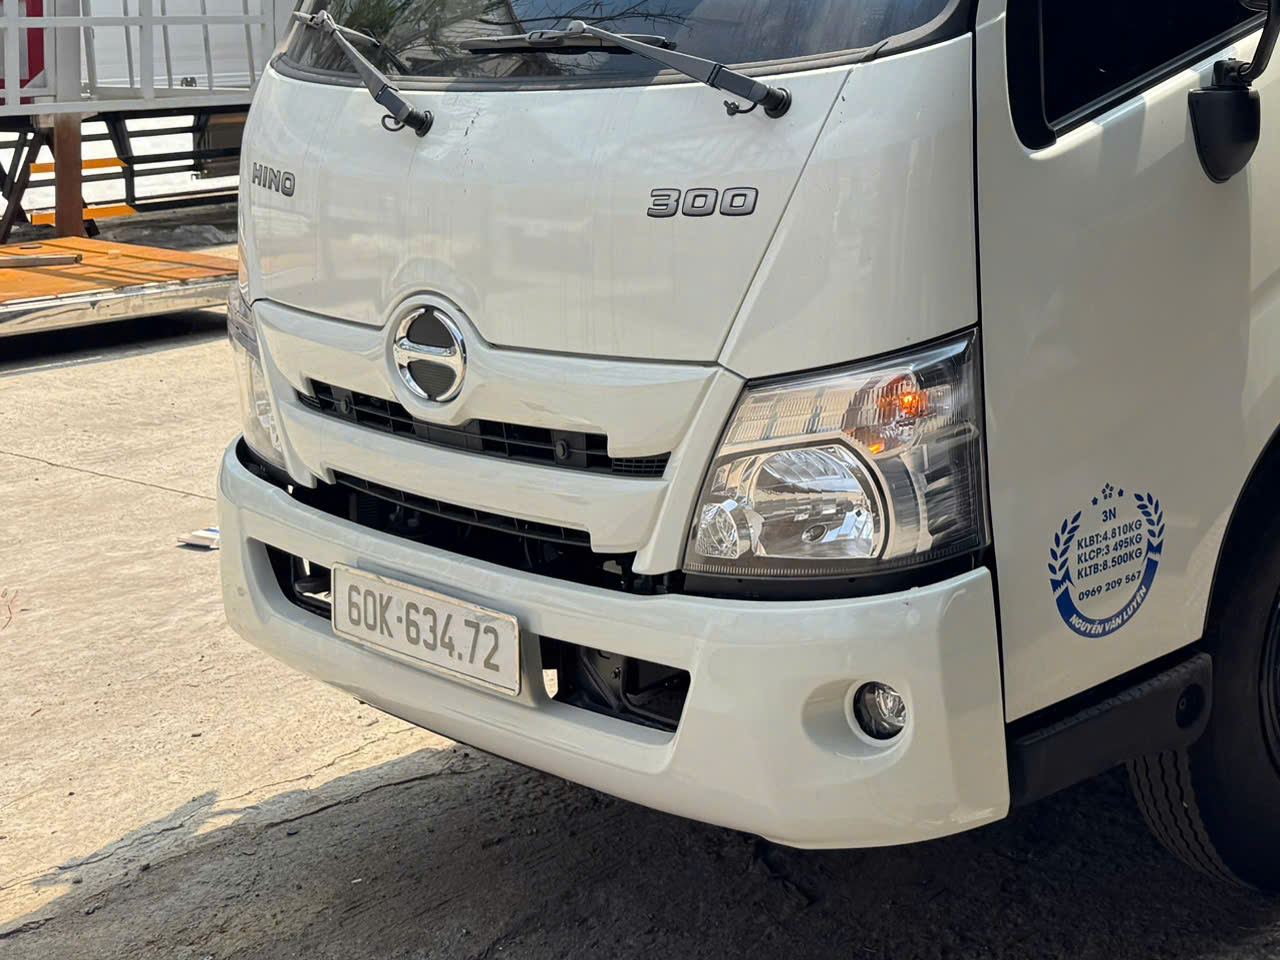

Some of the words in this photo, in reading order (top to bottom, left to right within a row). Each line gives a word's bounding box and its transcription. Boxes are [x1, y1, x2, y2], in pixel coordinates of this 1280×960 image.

[252, 161, 296, 197] HINO
[647, 186, 759, 219] 300
[1101, 507, 1117, 523] 3N
[1077, 519, 1143, 551] KLBT:4.810KG
[1077, 547, 1143, 580] KLTB:8.500KG
[1078, 584, 1103, 602] 0969
[1104, 576, 1123, 592] 209
[1124, 570, 1142, 585] 567
[347, 583, 501, 673] 60K-634.72
